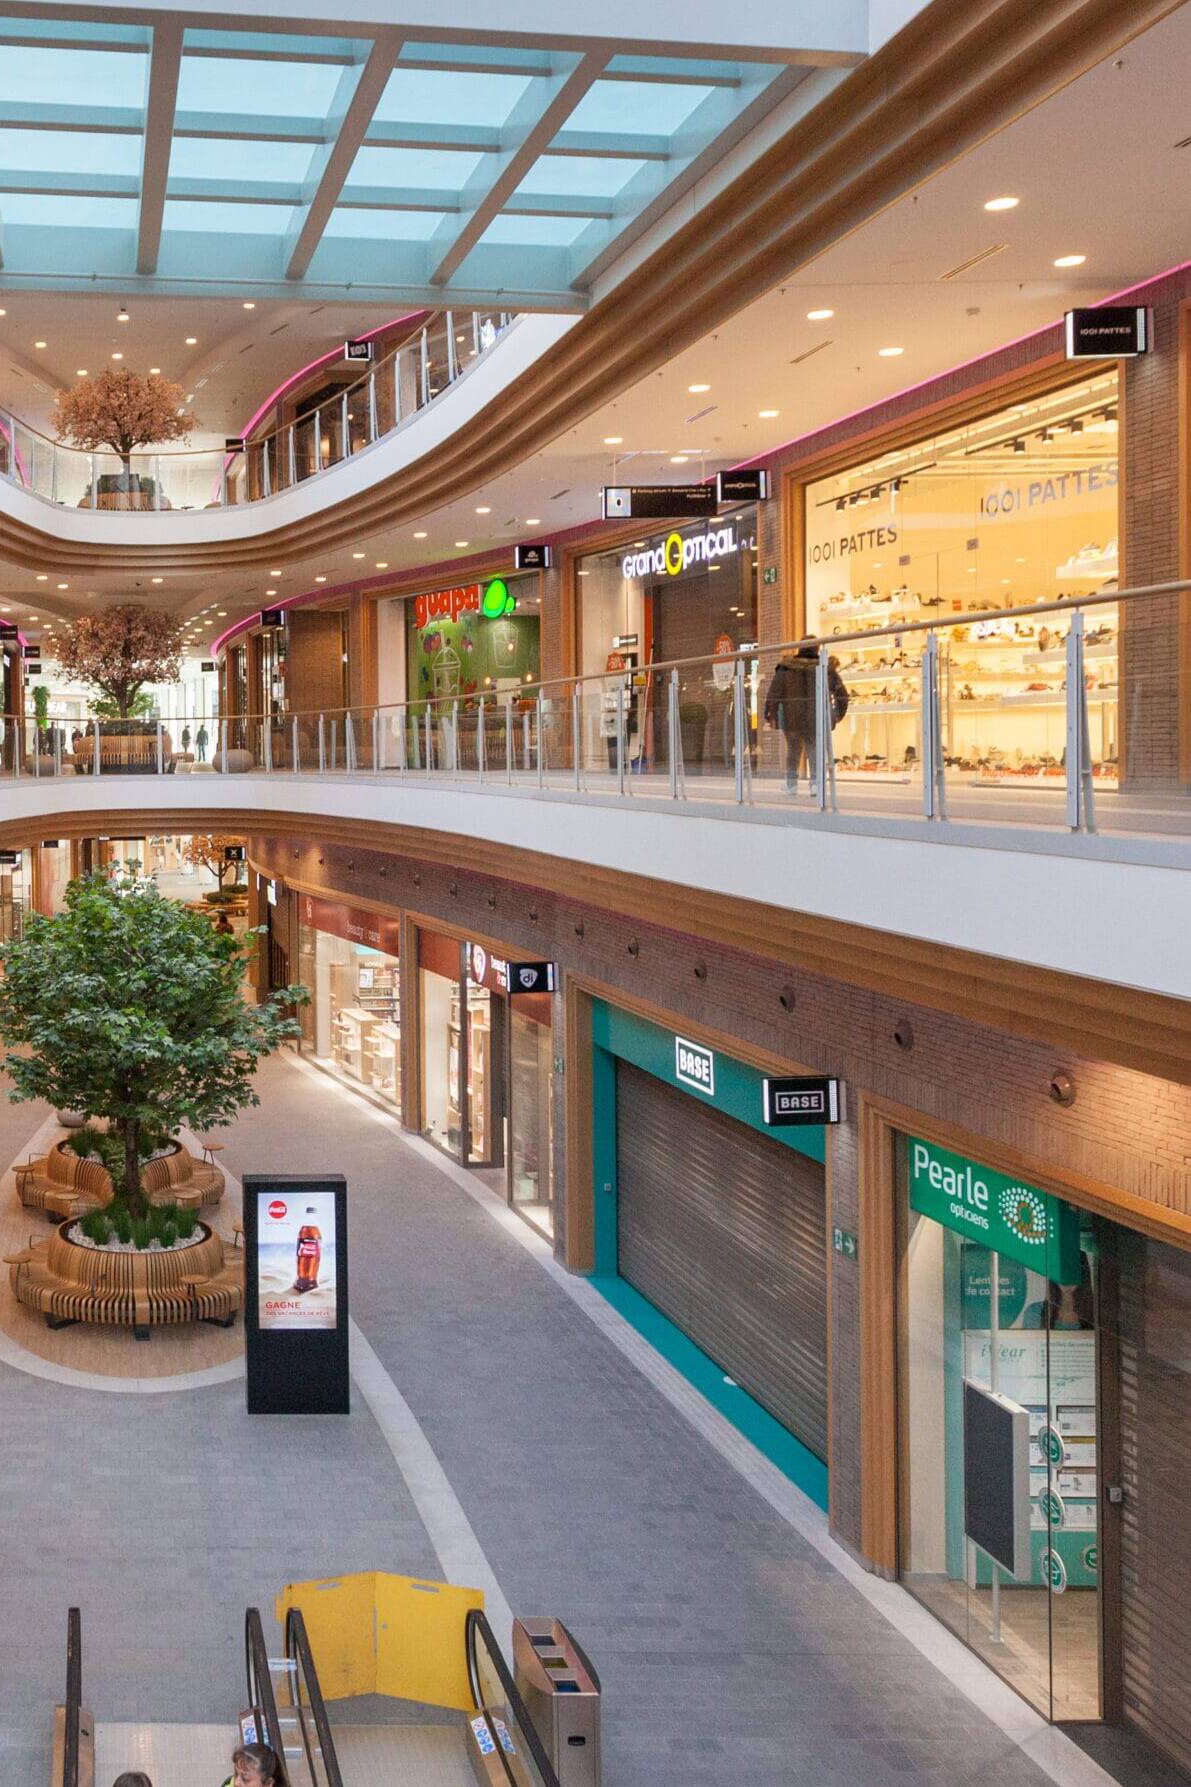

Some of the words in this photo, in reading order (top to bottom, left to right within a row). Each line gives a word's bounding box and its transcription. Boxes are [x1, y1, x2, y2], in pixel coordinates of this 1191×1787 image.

[1099, 326, 1131, 335] PATTES
[1028, 460, 1118, 508] PATTES
[839, 525, 898, 558] PATTES
[414, 583, 480, 629] guapa
[679, 1048, 711, 1082] BASE
[780, 1095, 820, 1109] BASE
[914, 1143, 990, 1211] Pearle
[950, 1201, 990, 1230] opticiens
[265, 1301, 301, 1309] GAGNE
